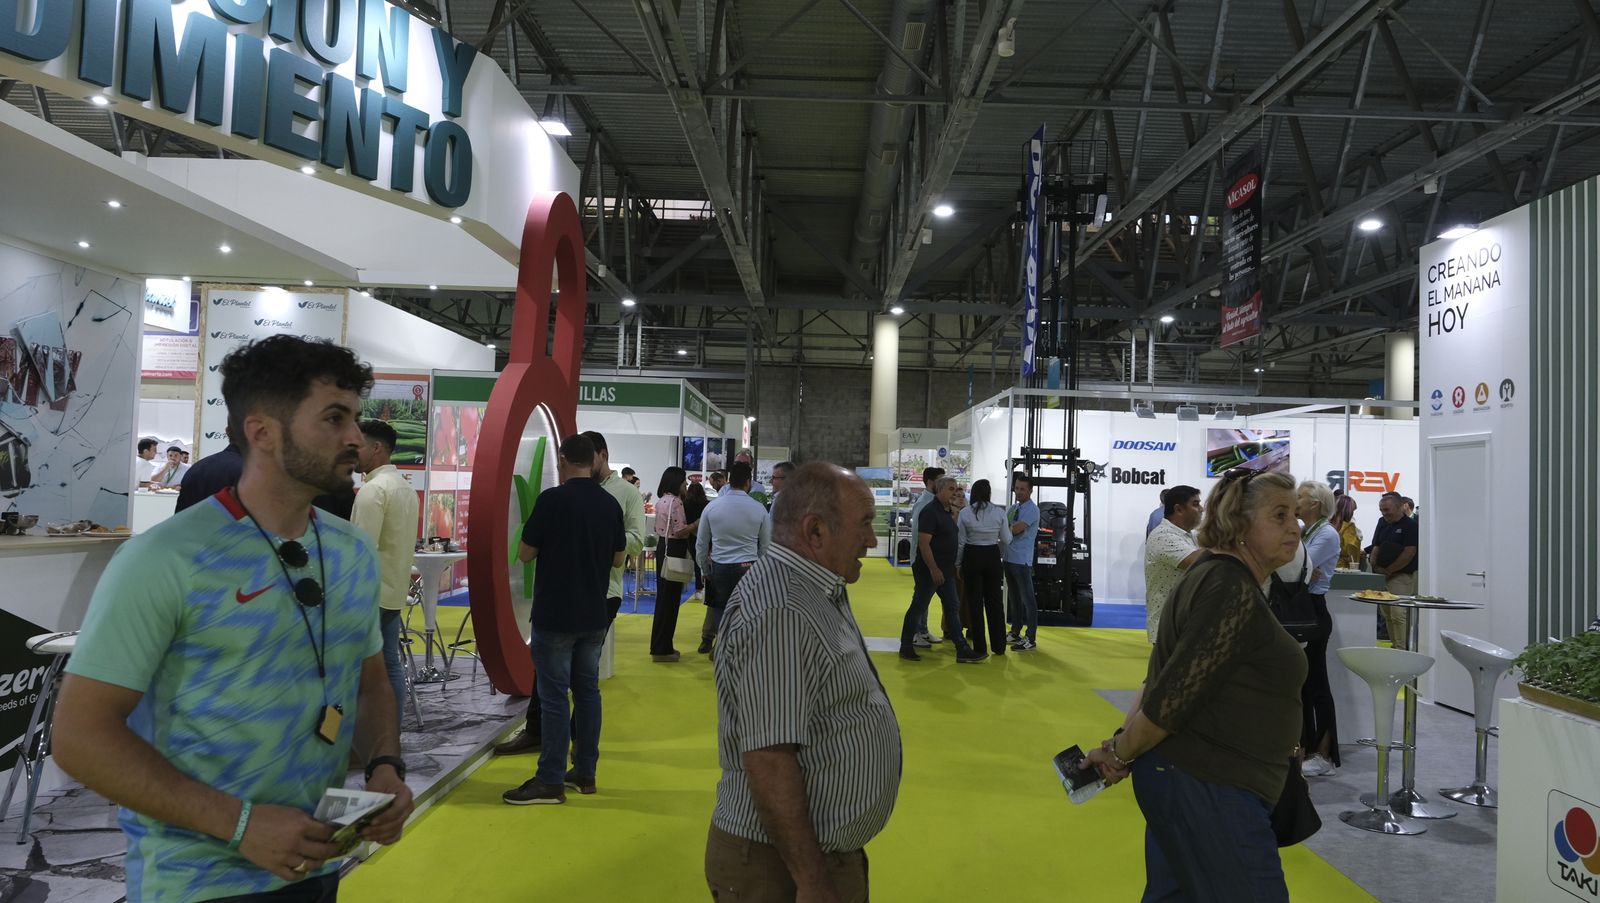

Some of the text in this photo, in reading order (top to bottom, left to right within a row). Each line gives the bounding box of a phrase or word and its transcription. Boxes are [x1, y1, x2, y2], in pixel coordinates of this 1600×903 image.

[430, 26, 477, 118] Y
[1227, 178, 1257, 206] VICASOL
[1427, 242, 1502, 284] CREANDO
[1428, 269, 1501, 307] EL MAÑANA
[271, 319, 294, 328] Plantel
[1428, 302, 1470, 338] HOY
[1112, 440, 1177, 452] DOOSAN
[1111, 467, 1166, 486] Bobcat
[19, 695, 28, 707] of
